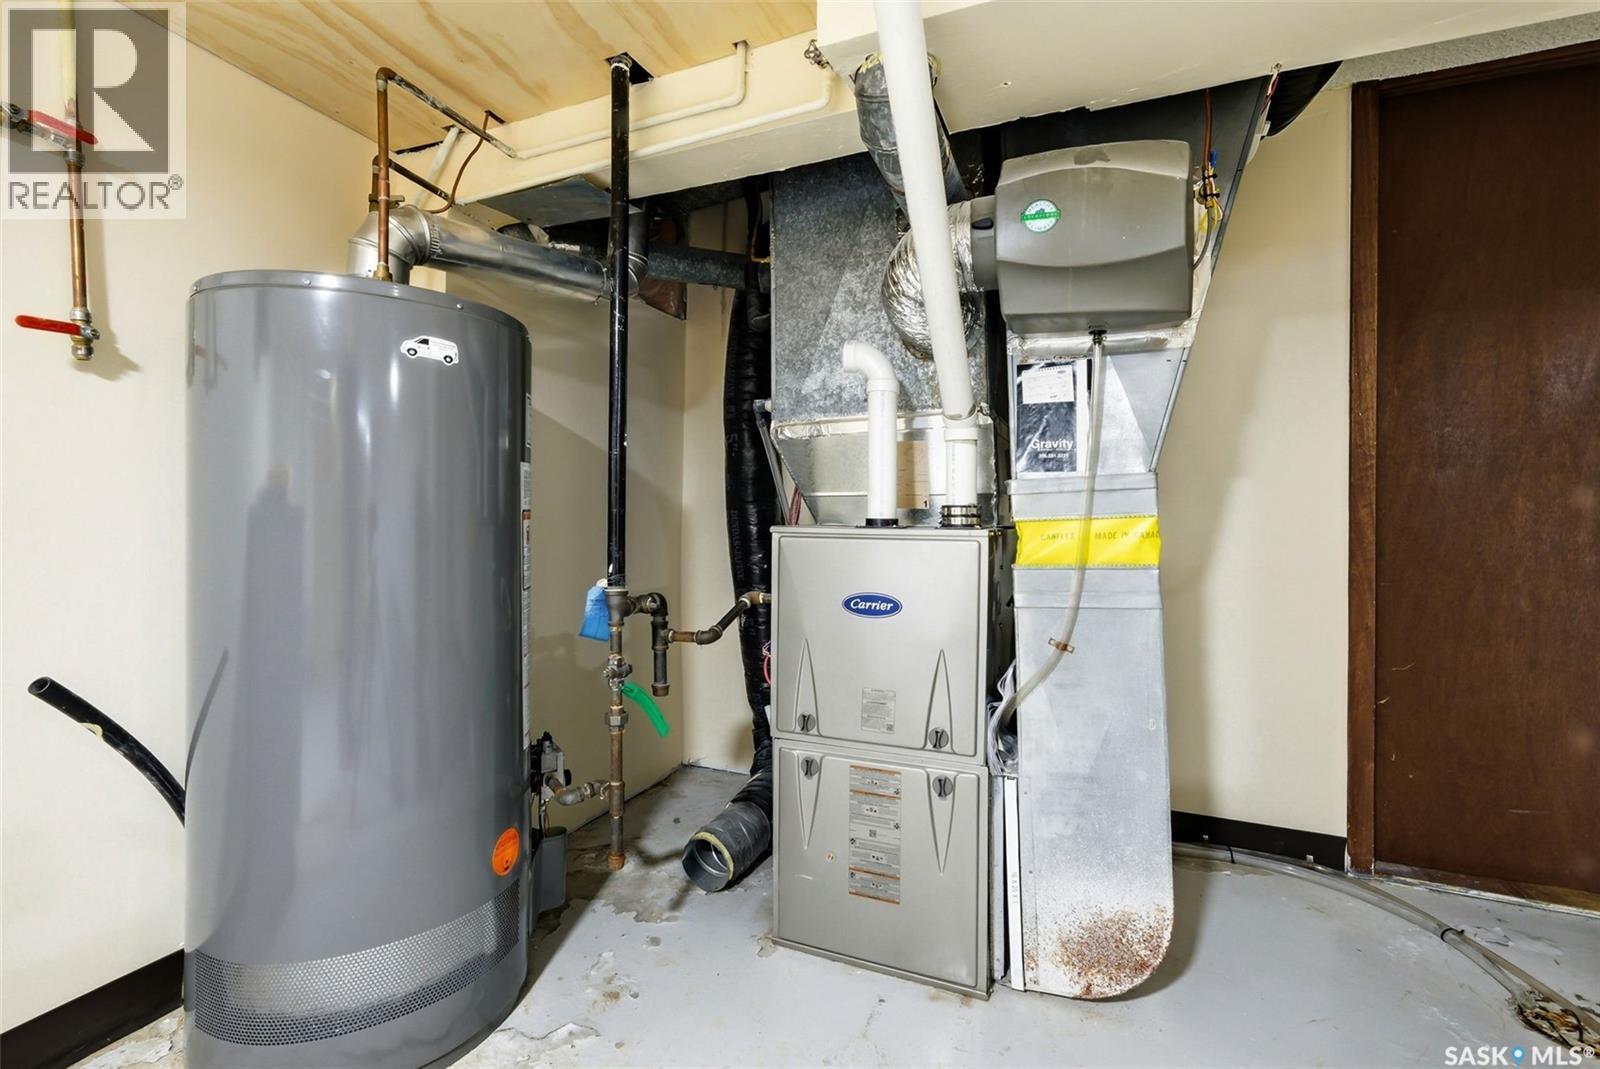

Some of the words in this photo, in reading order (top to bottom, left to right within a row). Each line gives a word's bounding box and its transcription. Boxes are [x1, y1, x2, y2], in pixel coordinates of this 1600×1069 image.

[1031, 438, 1073, 451] Gravity
[1095, 531, 1117, 539] MADE
[850, 598, 894, 611] Carrier
